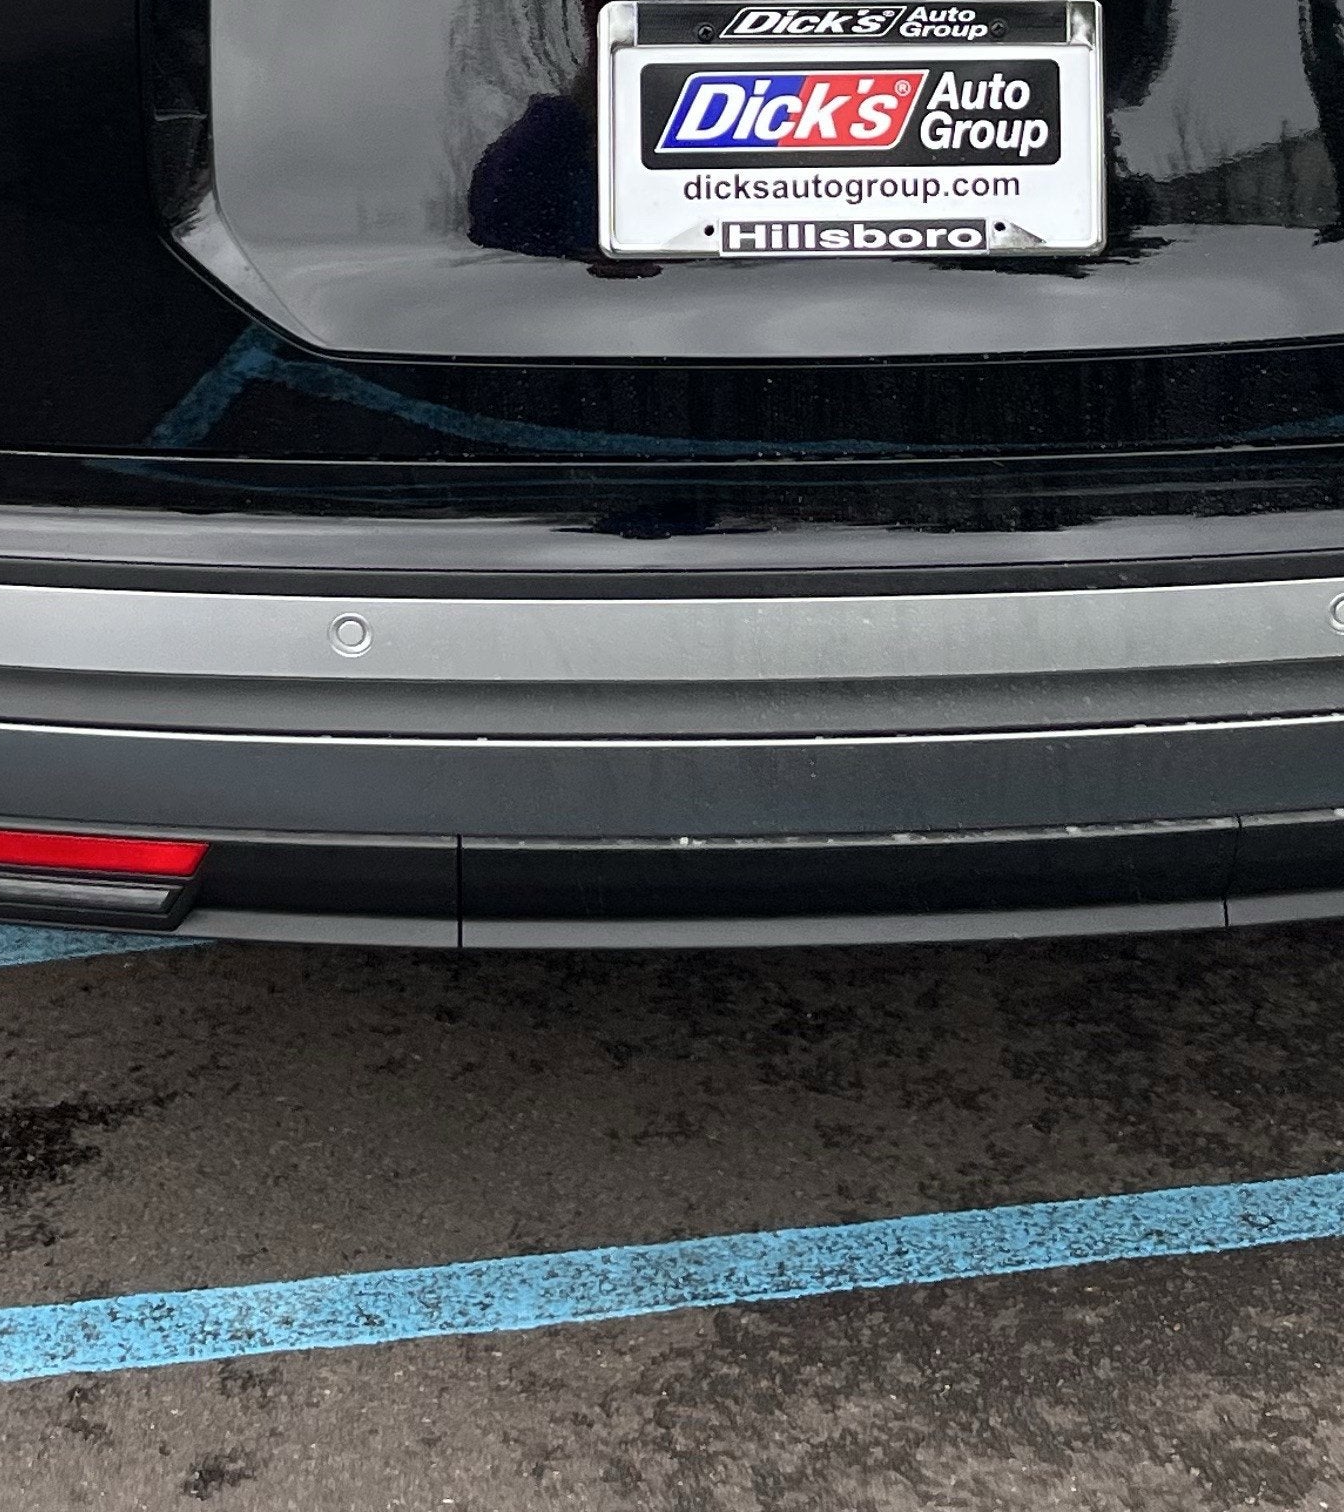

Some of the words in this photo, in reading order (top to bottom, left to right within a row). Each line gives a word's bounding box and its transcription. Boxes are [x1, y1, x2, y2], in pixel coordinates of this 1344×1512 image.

[733, 9, 887, 34] Dick's
[906, 6, 976, 22] Auto
[899, 21, 989, 41] Group
[674, 76, 899, 142] Dick's
[926, 71, 1031, 111] Auto
[919, 111, 1049, 157] Group
[683, 172, 1021, 205] dicksautogroup.com
[728, 223, 984, 251] Hillsboro
